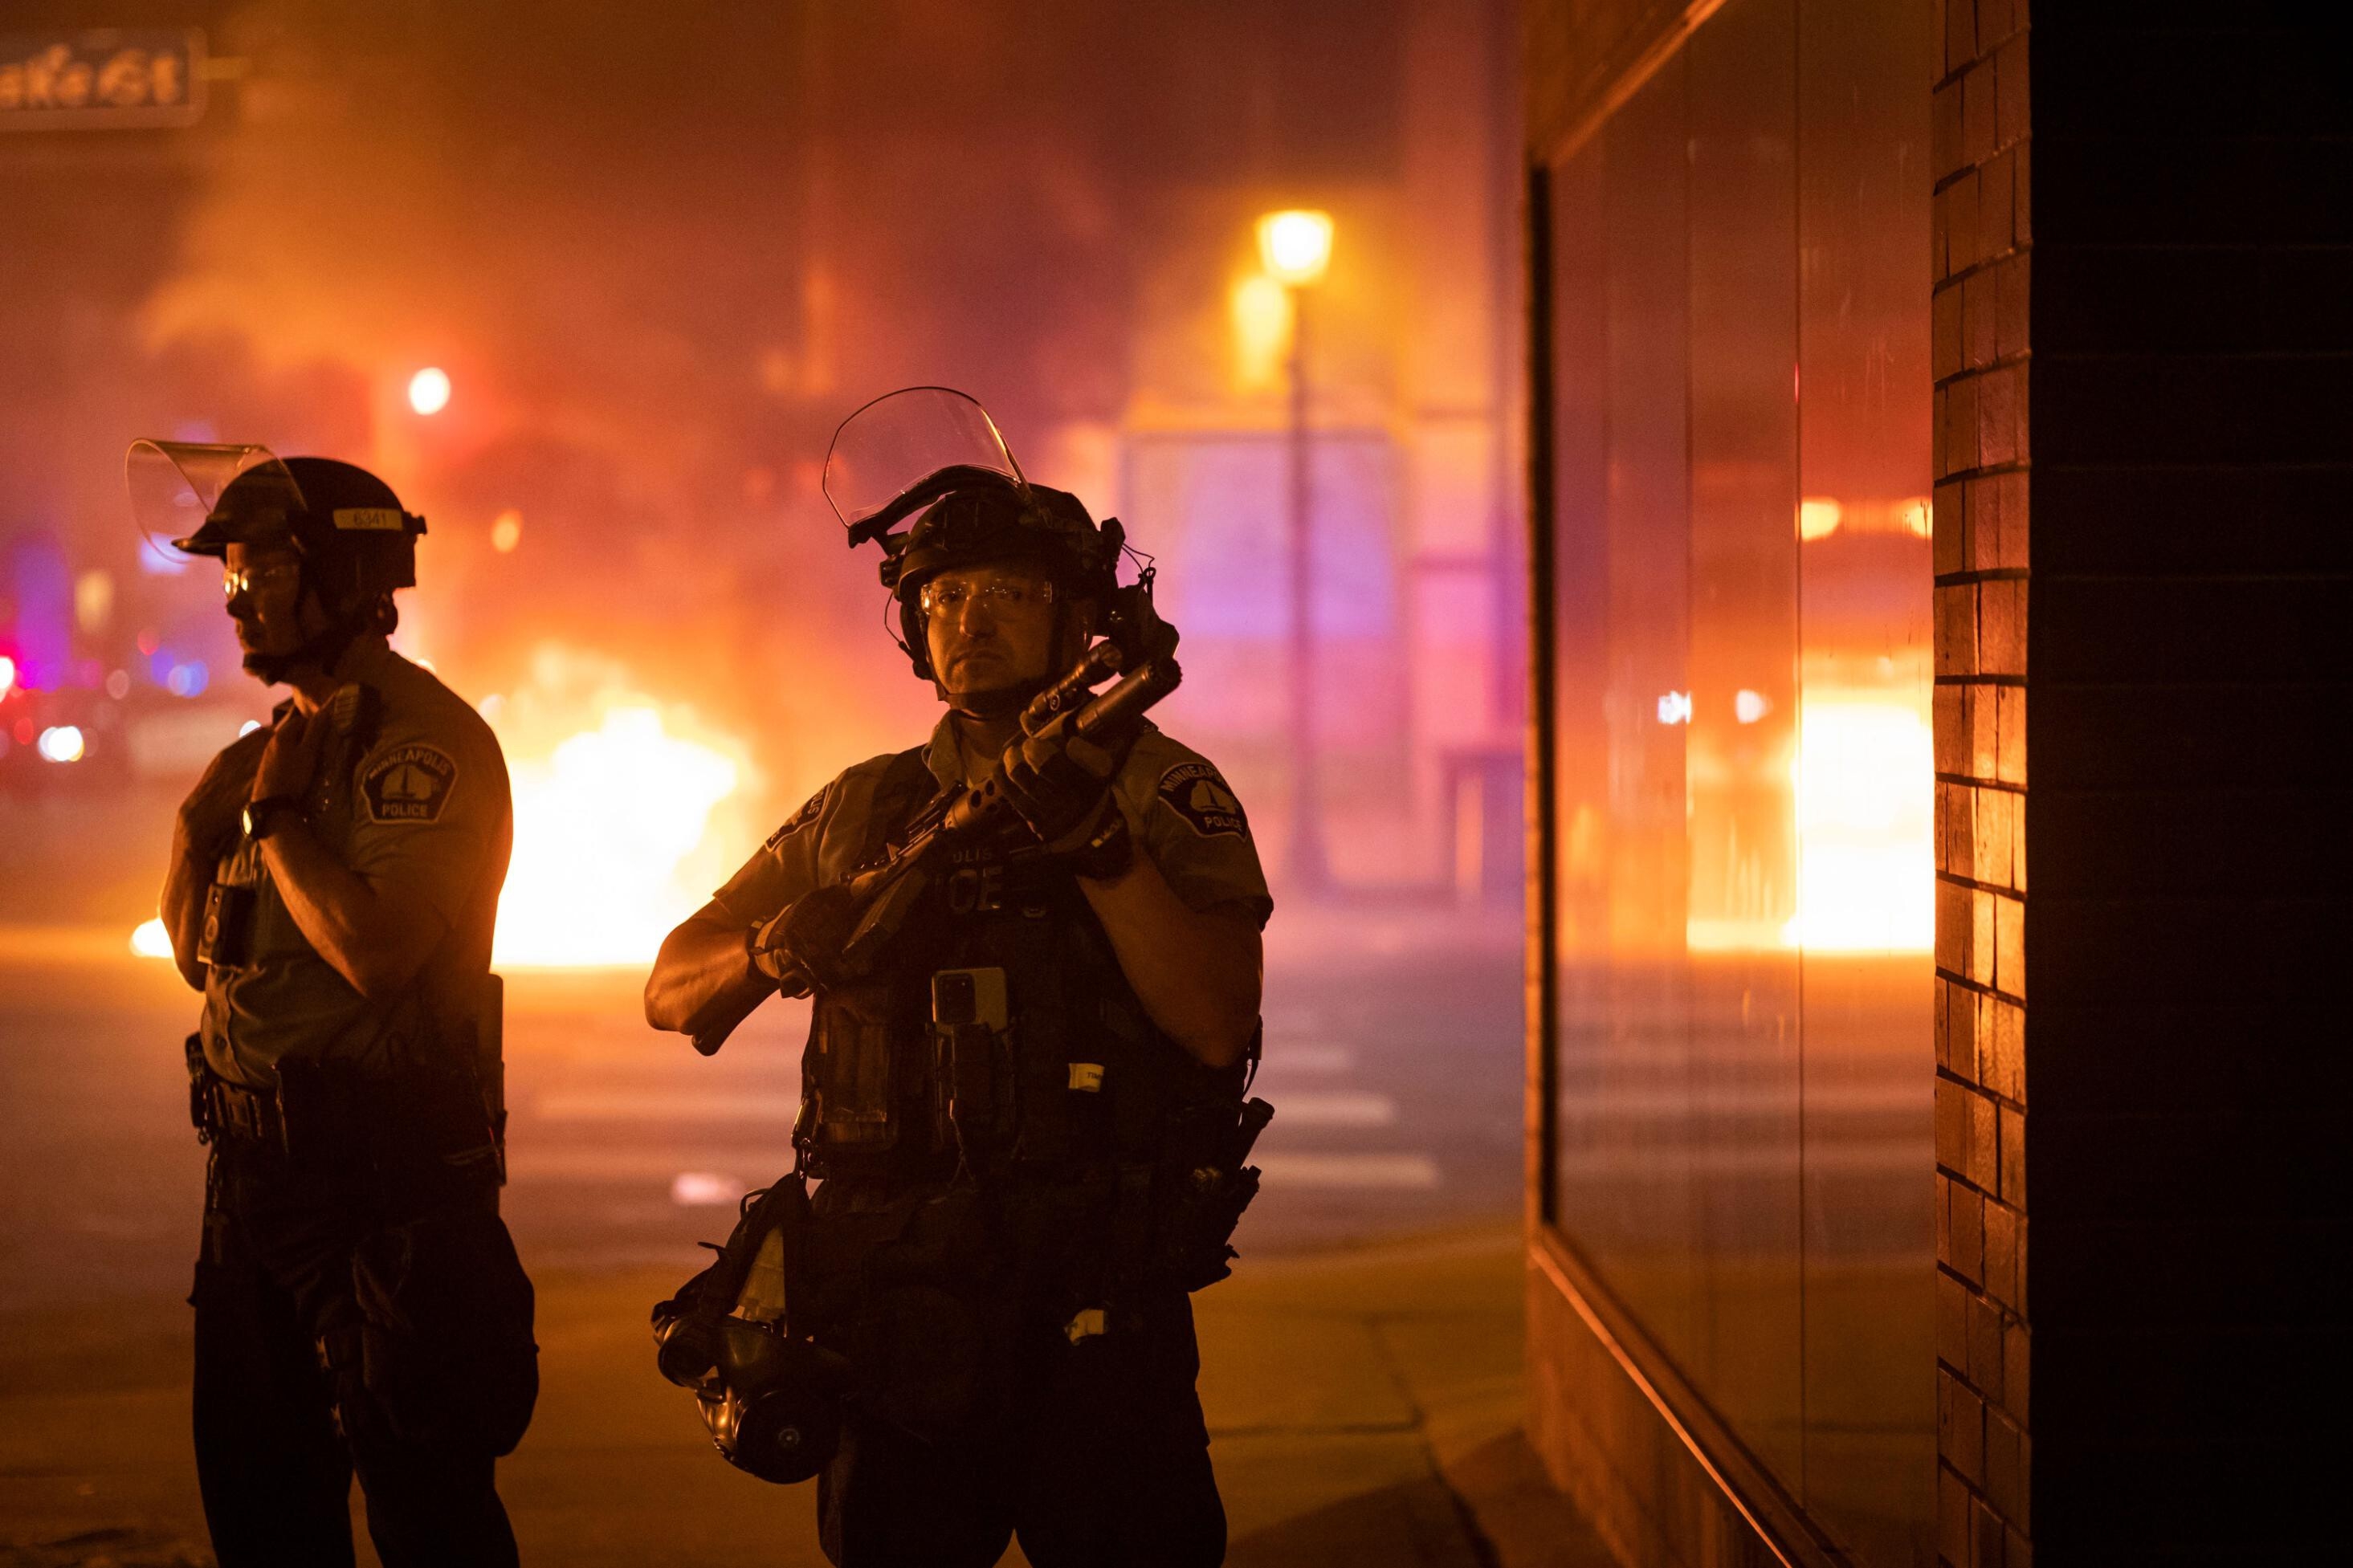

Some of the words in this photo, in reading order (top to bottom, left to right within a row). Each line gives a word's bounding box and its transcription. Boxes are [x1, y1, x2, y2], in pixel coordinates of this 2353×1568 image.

[353, 511, 385, 527] 6341
[369, 749, 451, 779] MINNEAPOLIS
[382, 804, 428, 817] POLICE
